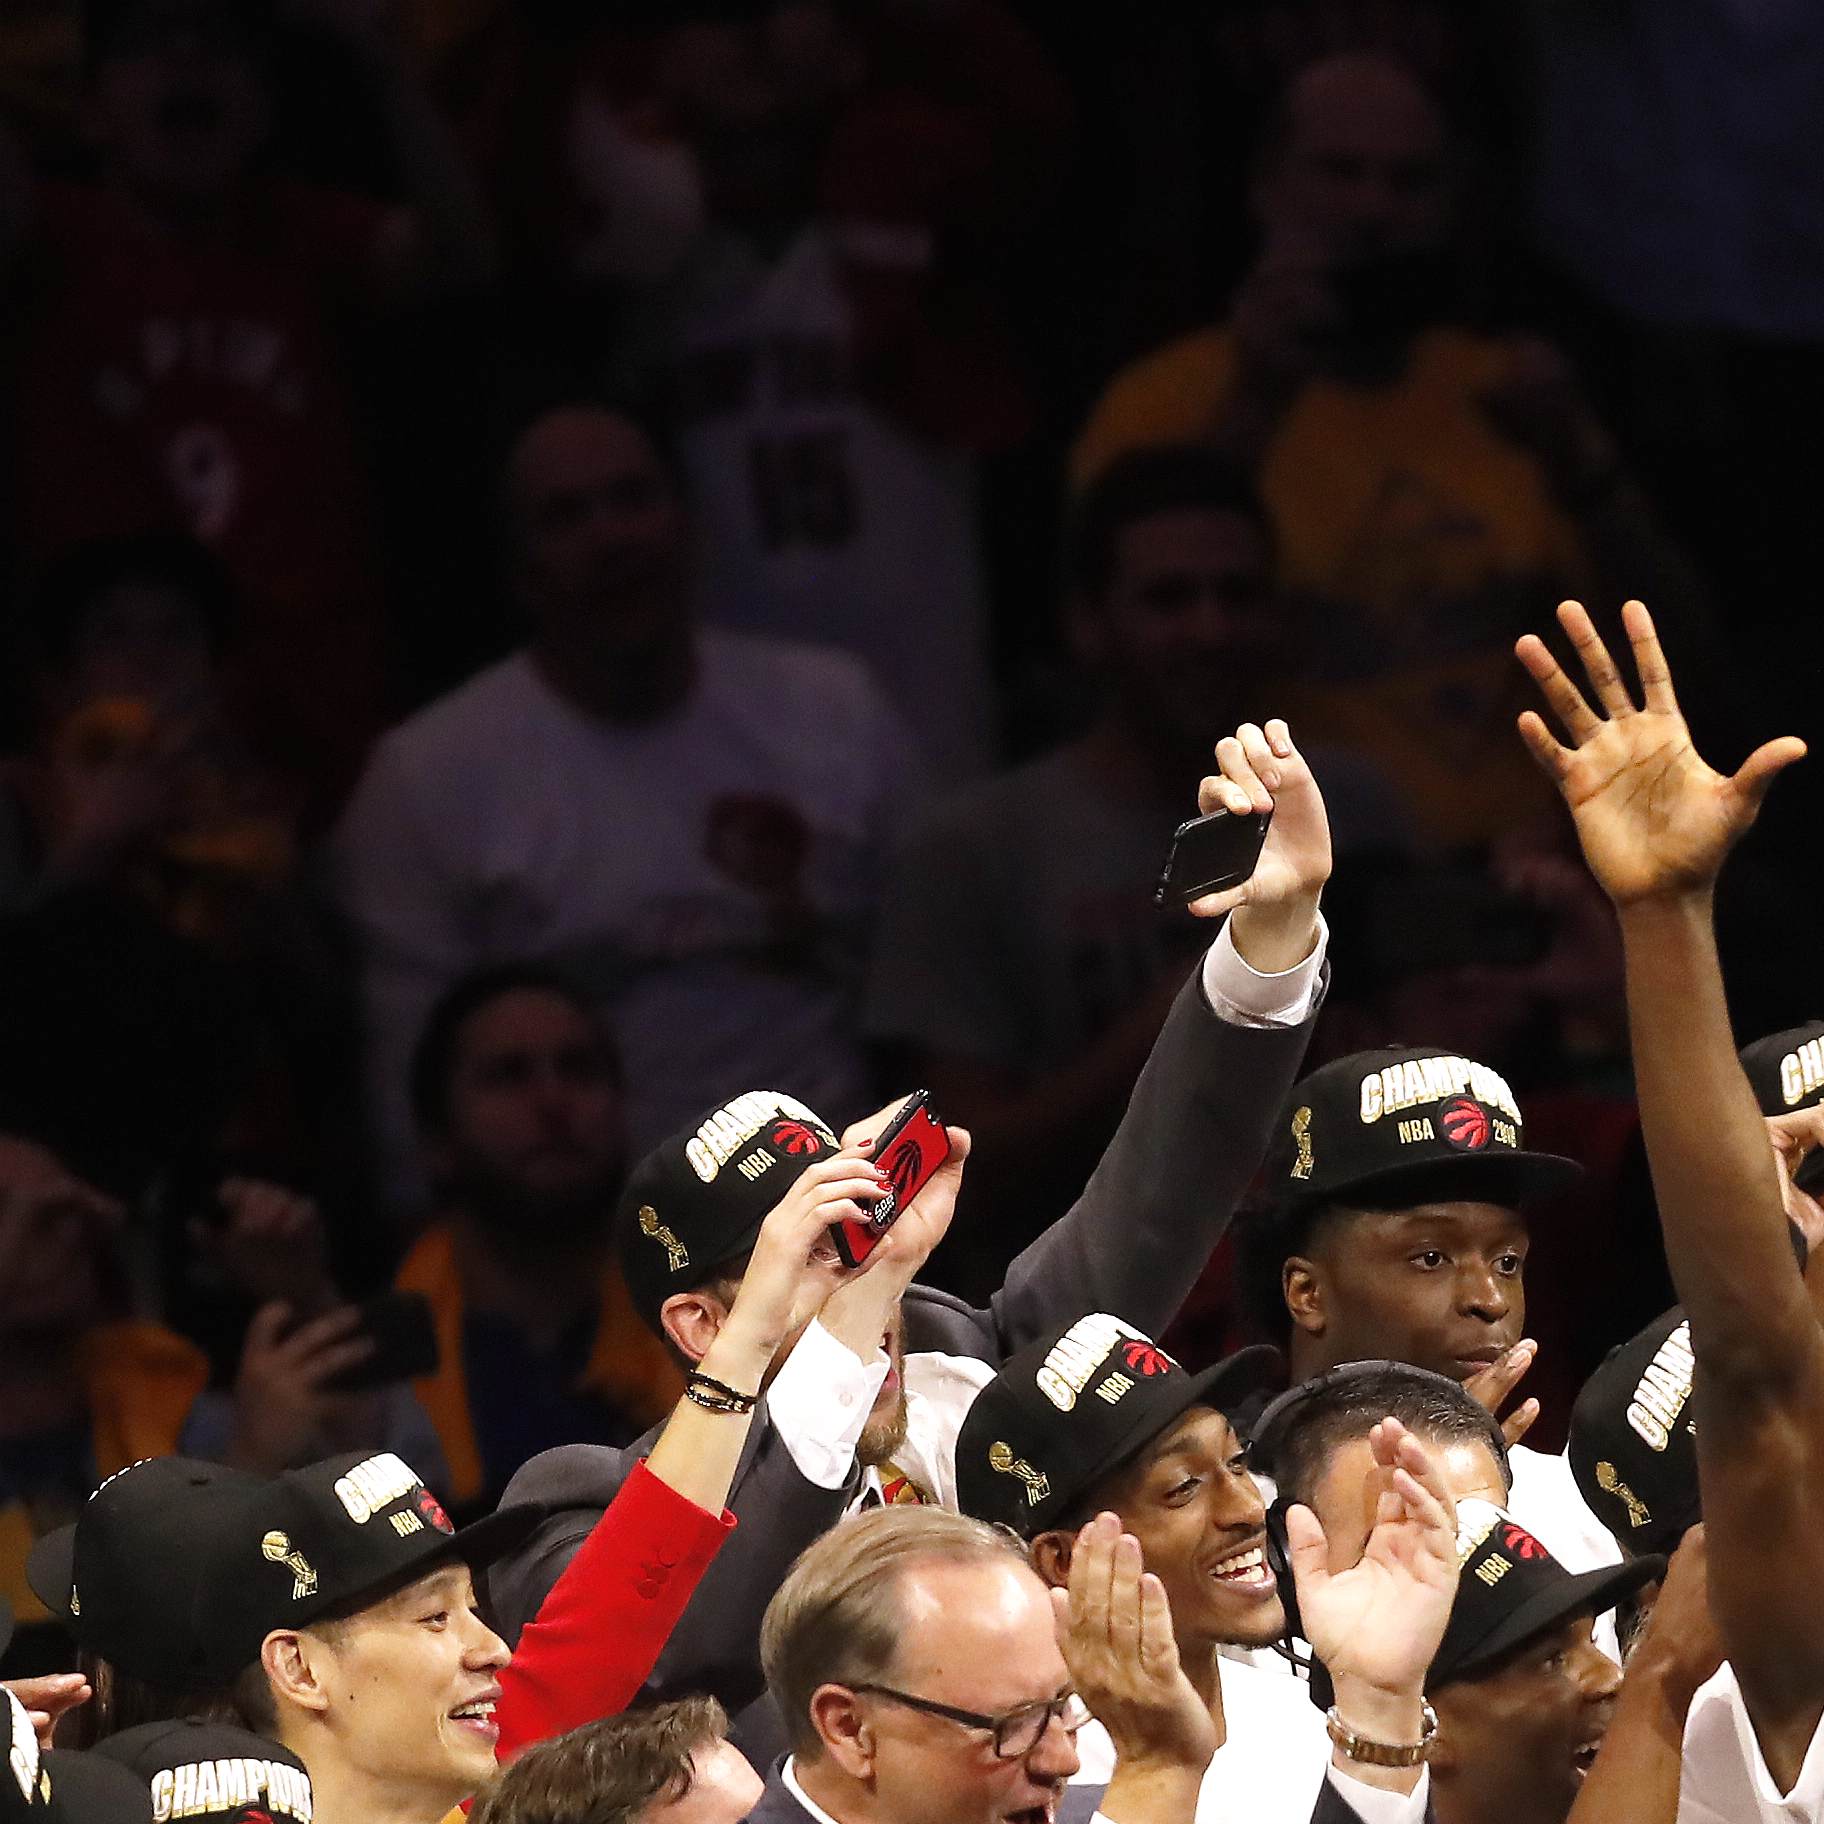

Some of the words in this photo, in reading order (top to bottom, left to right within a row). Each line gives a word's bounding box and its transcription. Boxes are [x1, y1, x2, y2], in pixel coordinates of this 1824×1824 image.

[1397, 1117, 1435, 1144] NBA
[737, 1147, 777, 1182] NBA
[1095, 1371, 1135, 1405] NBA
[388, 1508, 425, 1538] NBA
[1474, 1552, 1514, 1587] NBA
